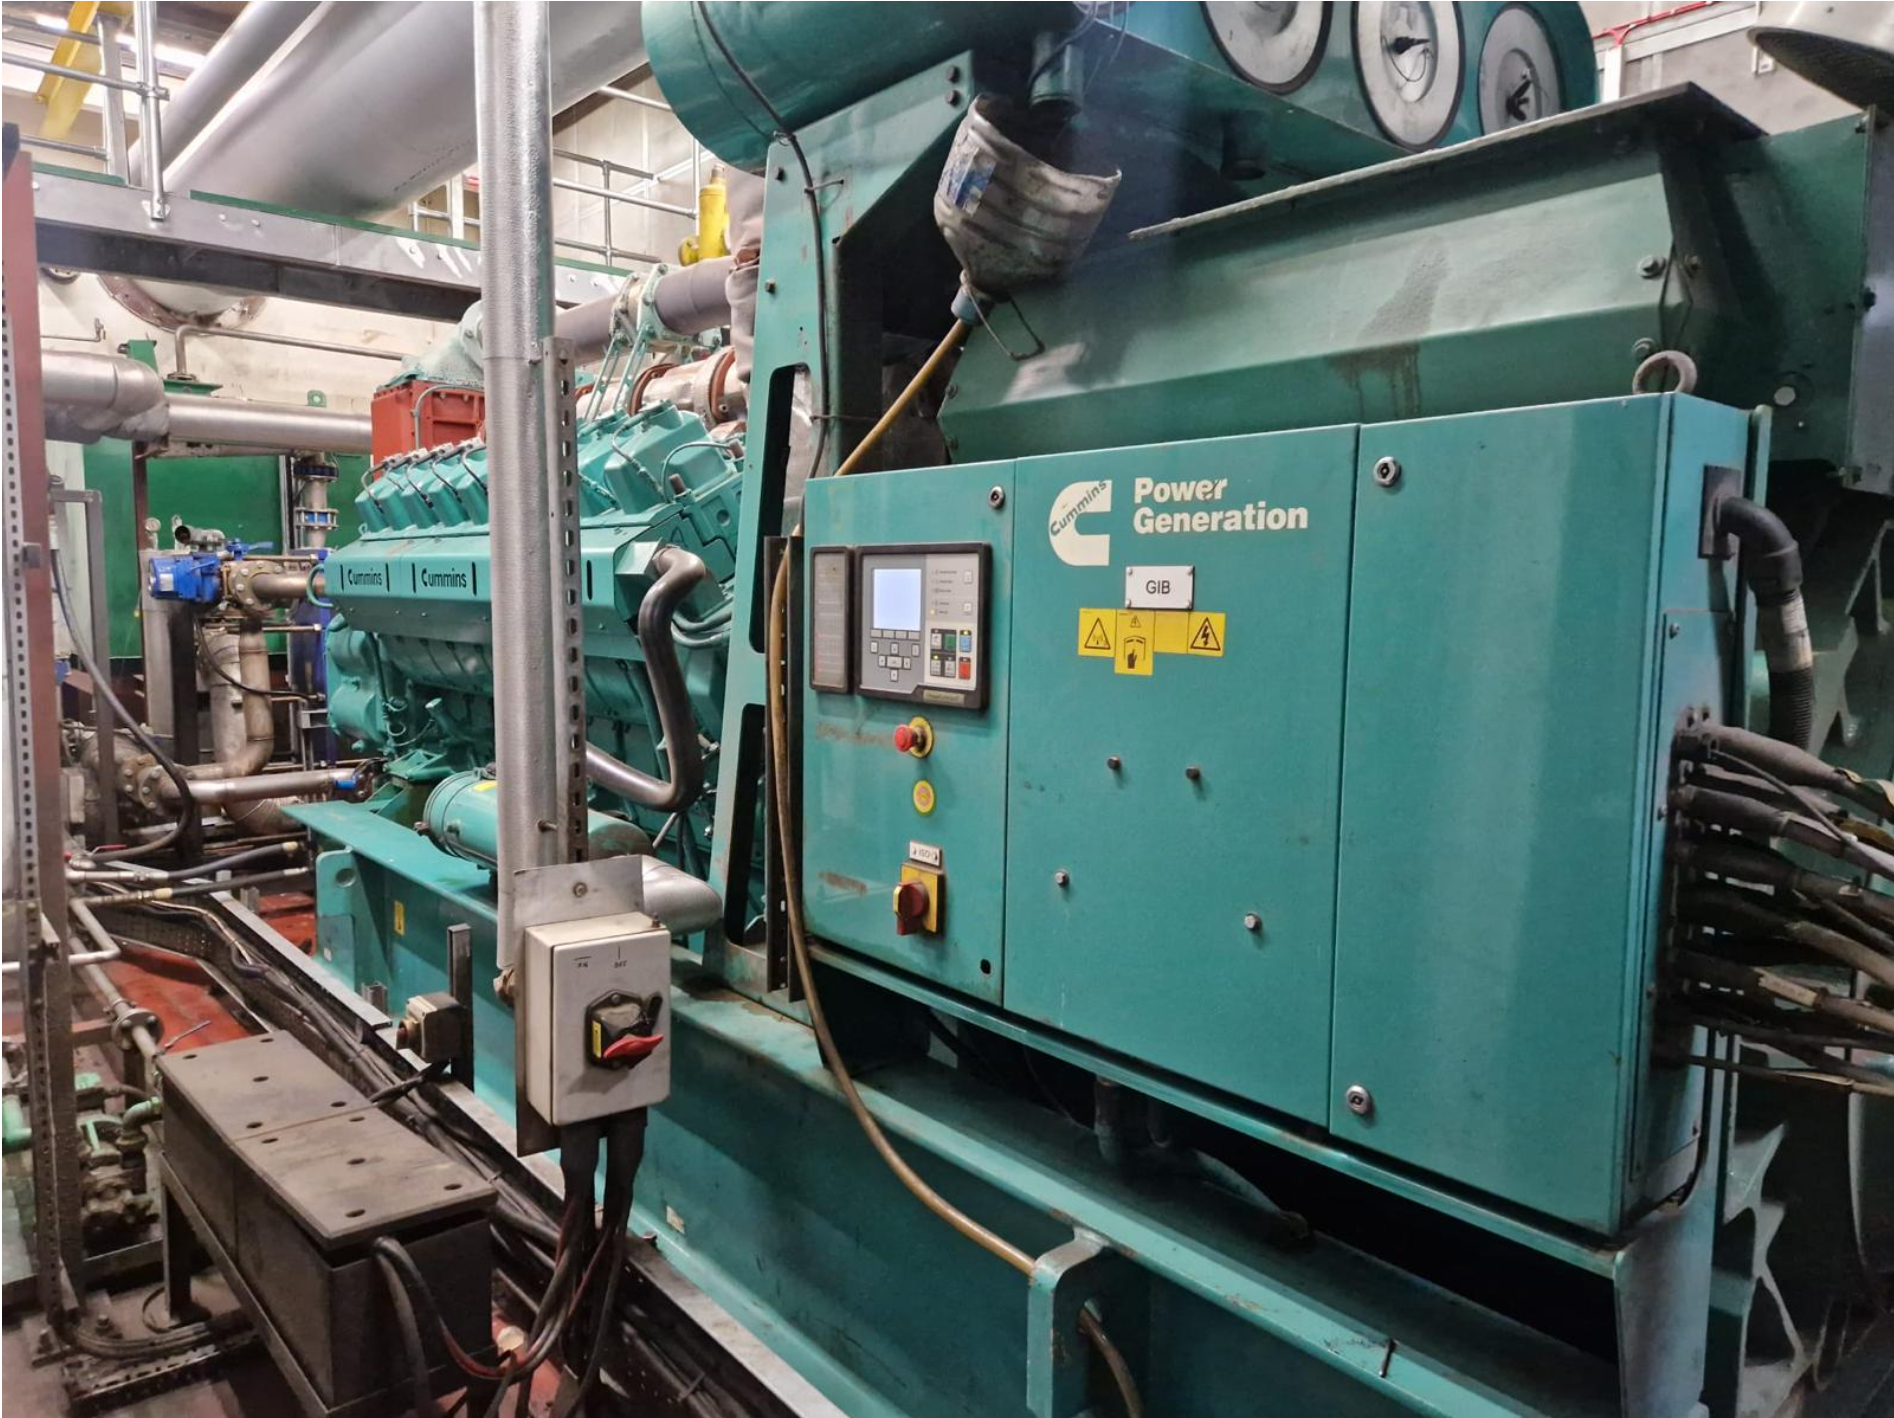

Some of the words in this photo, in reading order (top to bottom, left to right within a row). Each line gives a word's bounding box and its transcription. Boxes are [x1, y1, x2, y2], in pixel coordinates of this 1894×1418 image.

[1134, 477, 1228, 504] Power
[1050, 481, 1107, 537] Cummins
[1133, 501, 1308, 534] Generation
[348, 568, 382, 586] Cummins
[421, 567, 467, 588] Cummins
[1145, 580, 1171, 595] GIB
